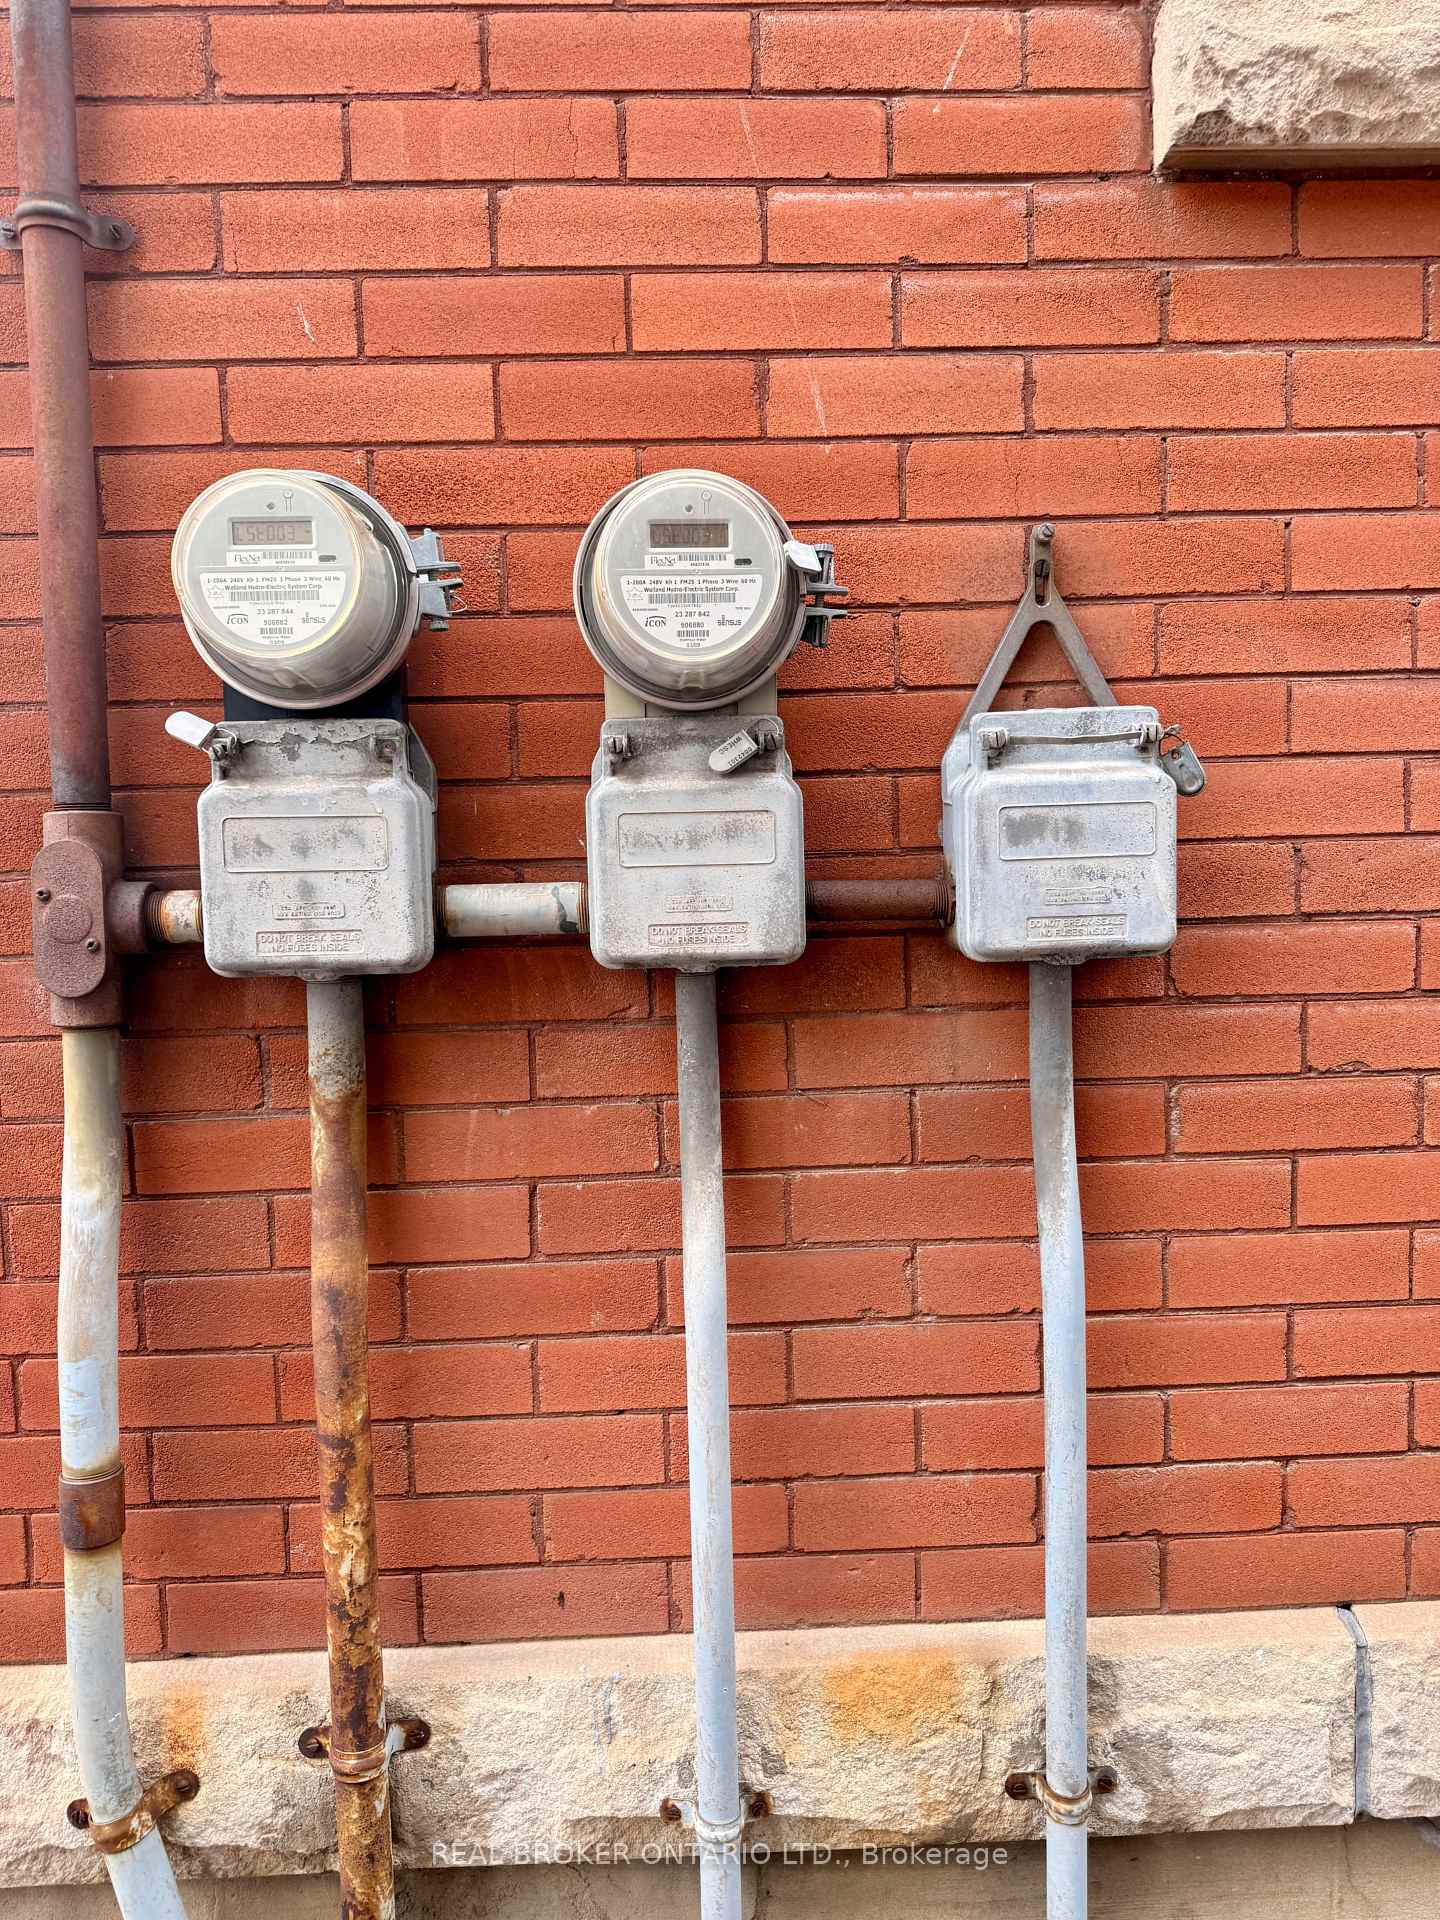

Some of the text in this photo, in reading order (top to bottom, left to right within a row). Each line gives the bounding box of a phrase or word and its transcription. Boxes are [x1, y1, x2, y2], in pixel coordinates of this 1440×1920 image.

[1055, 929, 1083, 937] FUSES
[677, 936, 705, 945] FUSES
[287, 944, 317, 953] FUSES
[320, 943, 349, 952] INSIDE
